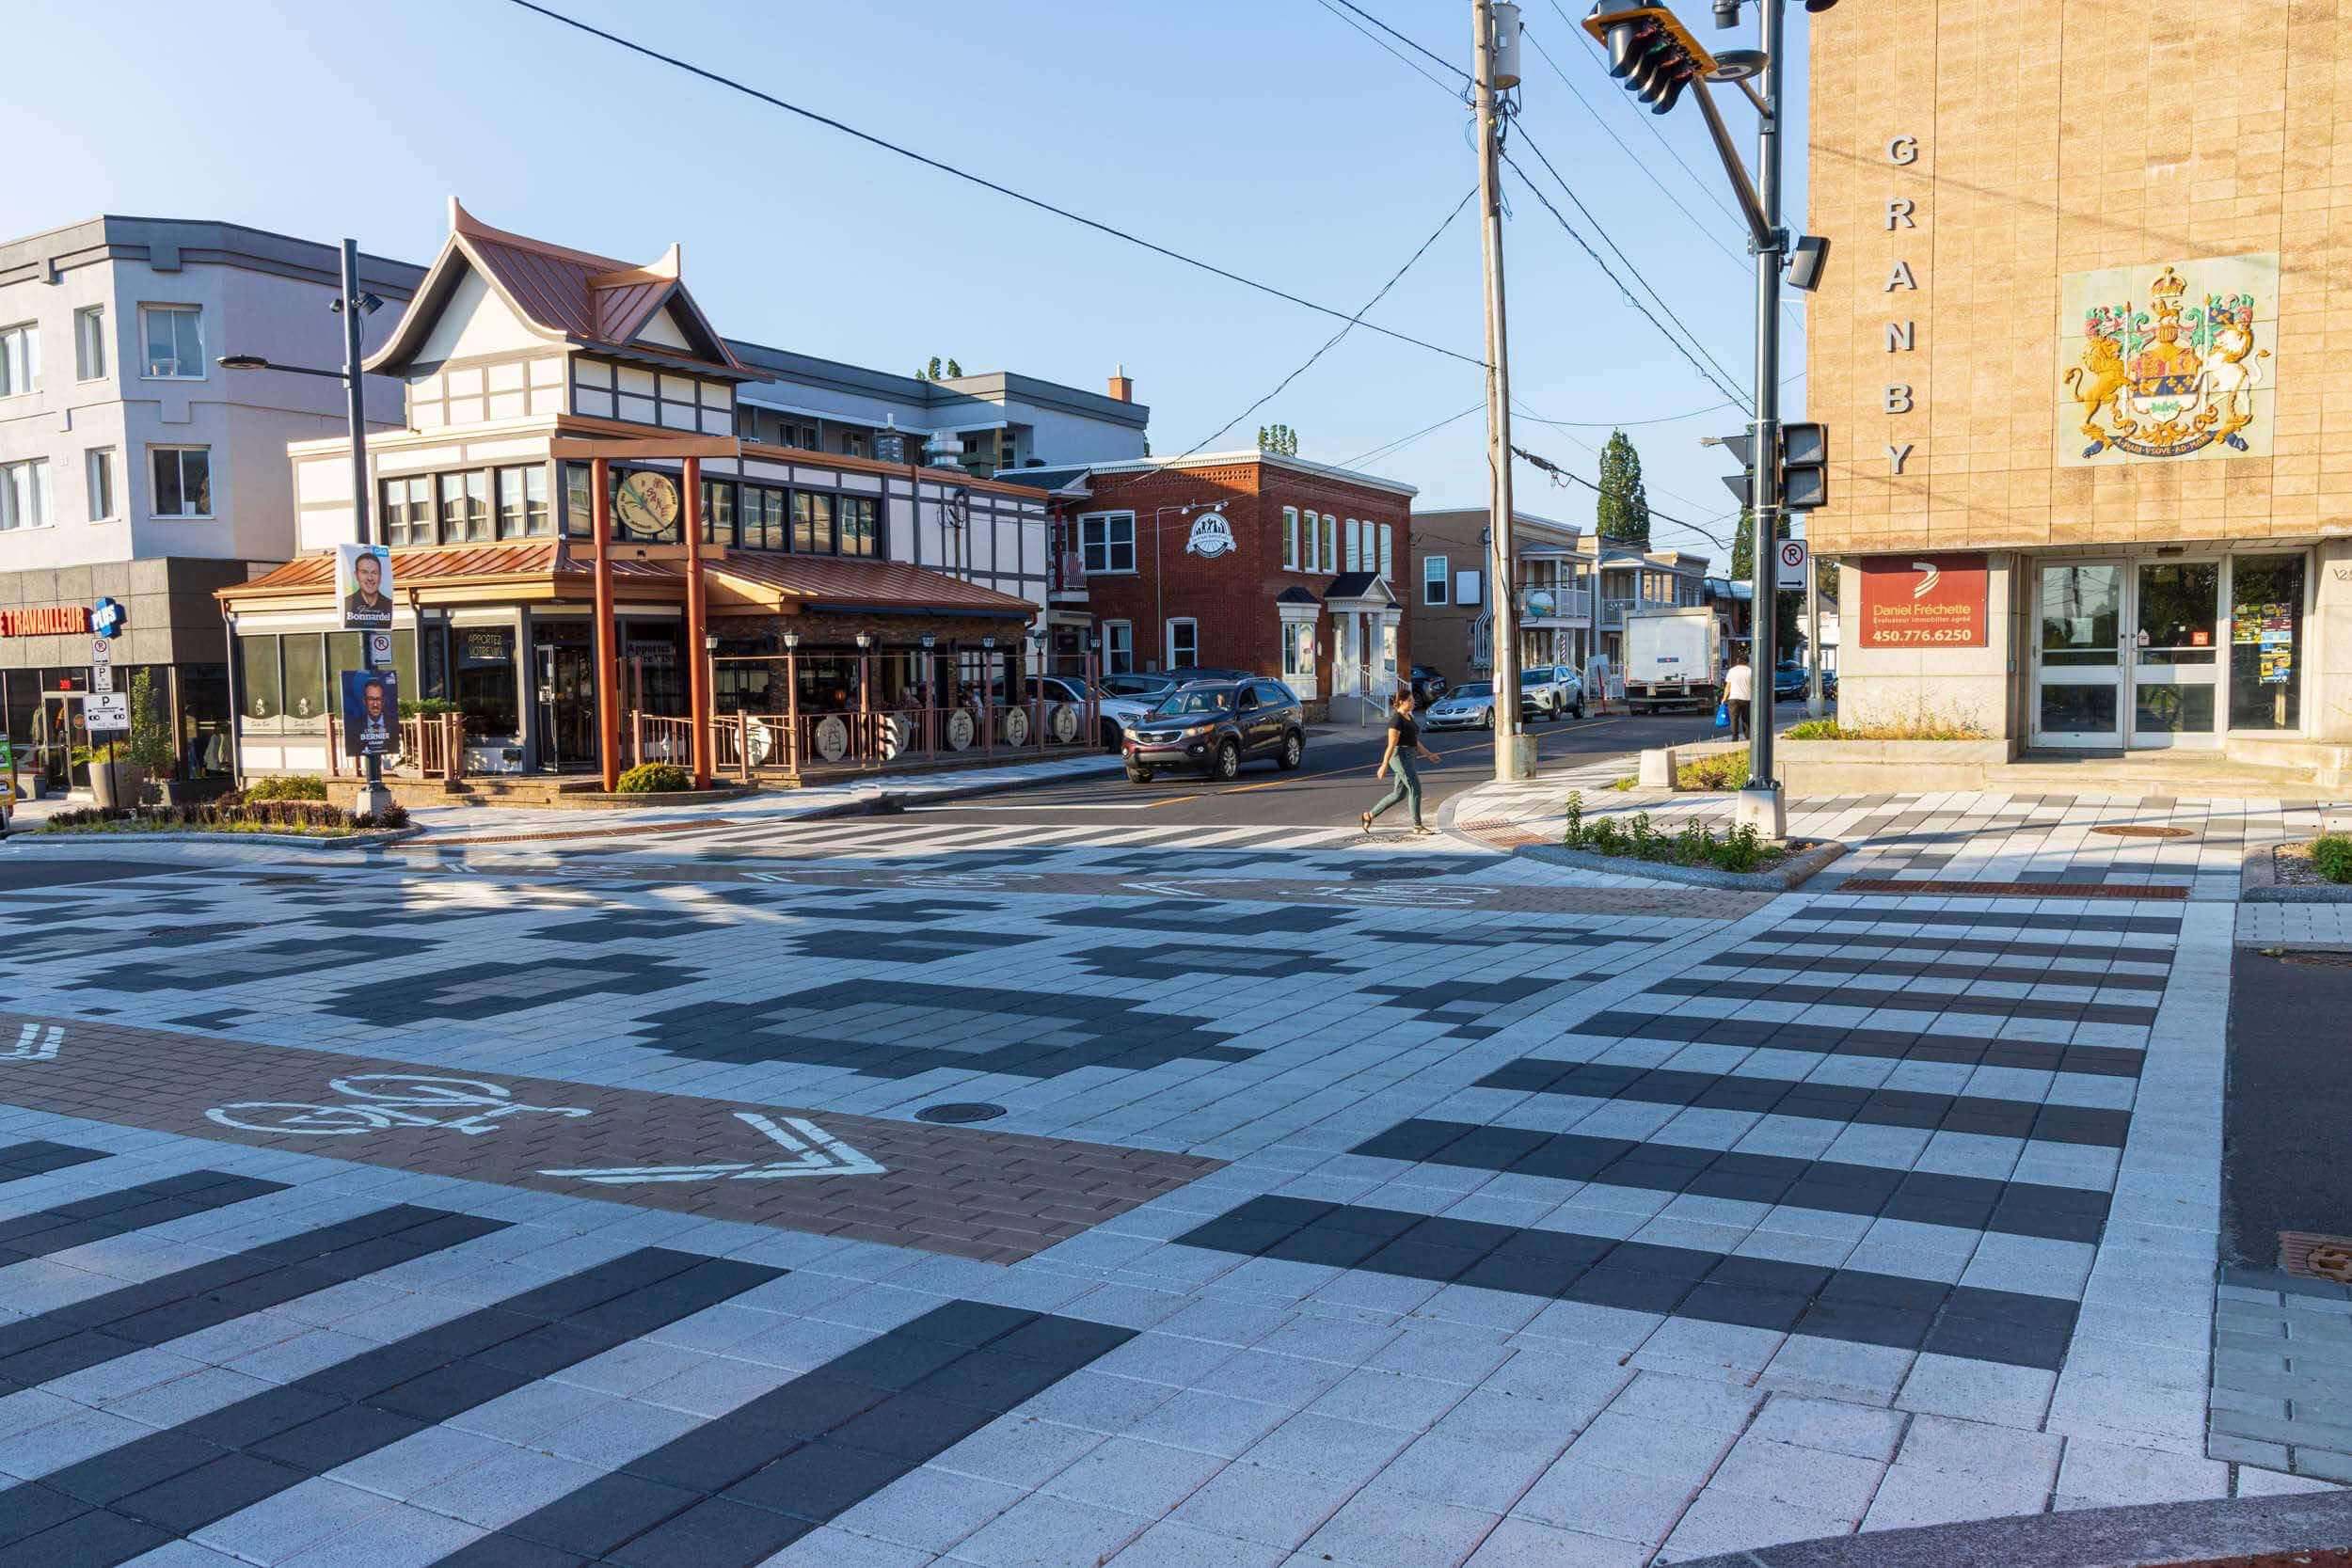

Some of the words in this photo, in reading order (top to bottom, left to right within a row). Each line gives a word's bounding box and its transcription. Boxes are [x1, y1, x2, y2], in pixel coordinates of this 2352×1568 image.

[1884, 135, 1917, 474] GRANBY
[91, 604, 117, 631] PLUS
[346, 611, 390, 621] Bonnardel
[1873, 604, 1912, 616] Daniel
[1914, 603, 1972, 615] Fréchette
[7, 606, 86, 636] TRAVAILLEUR
[1872, 629, 1972, 641] 450.776.6250
